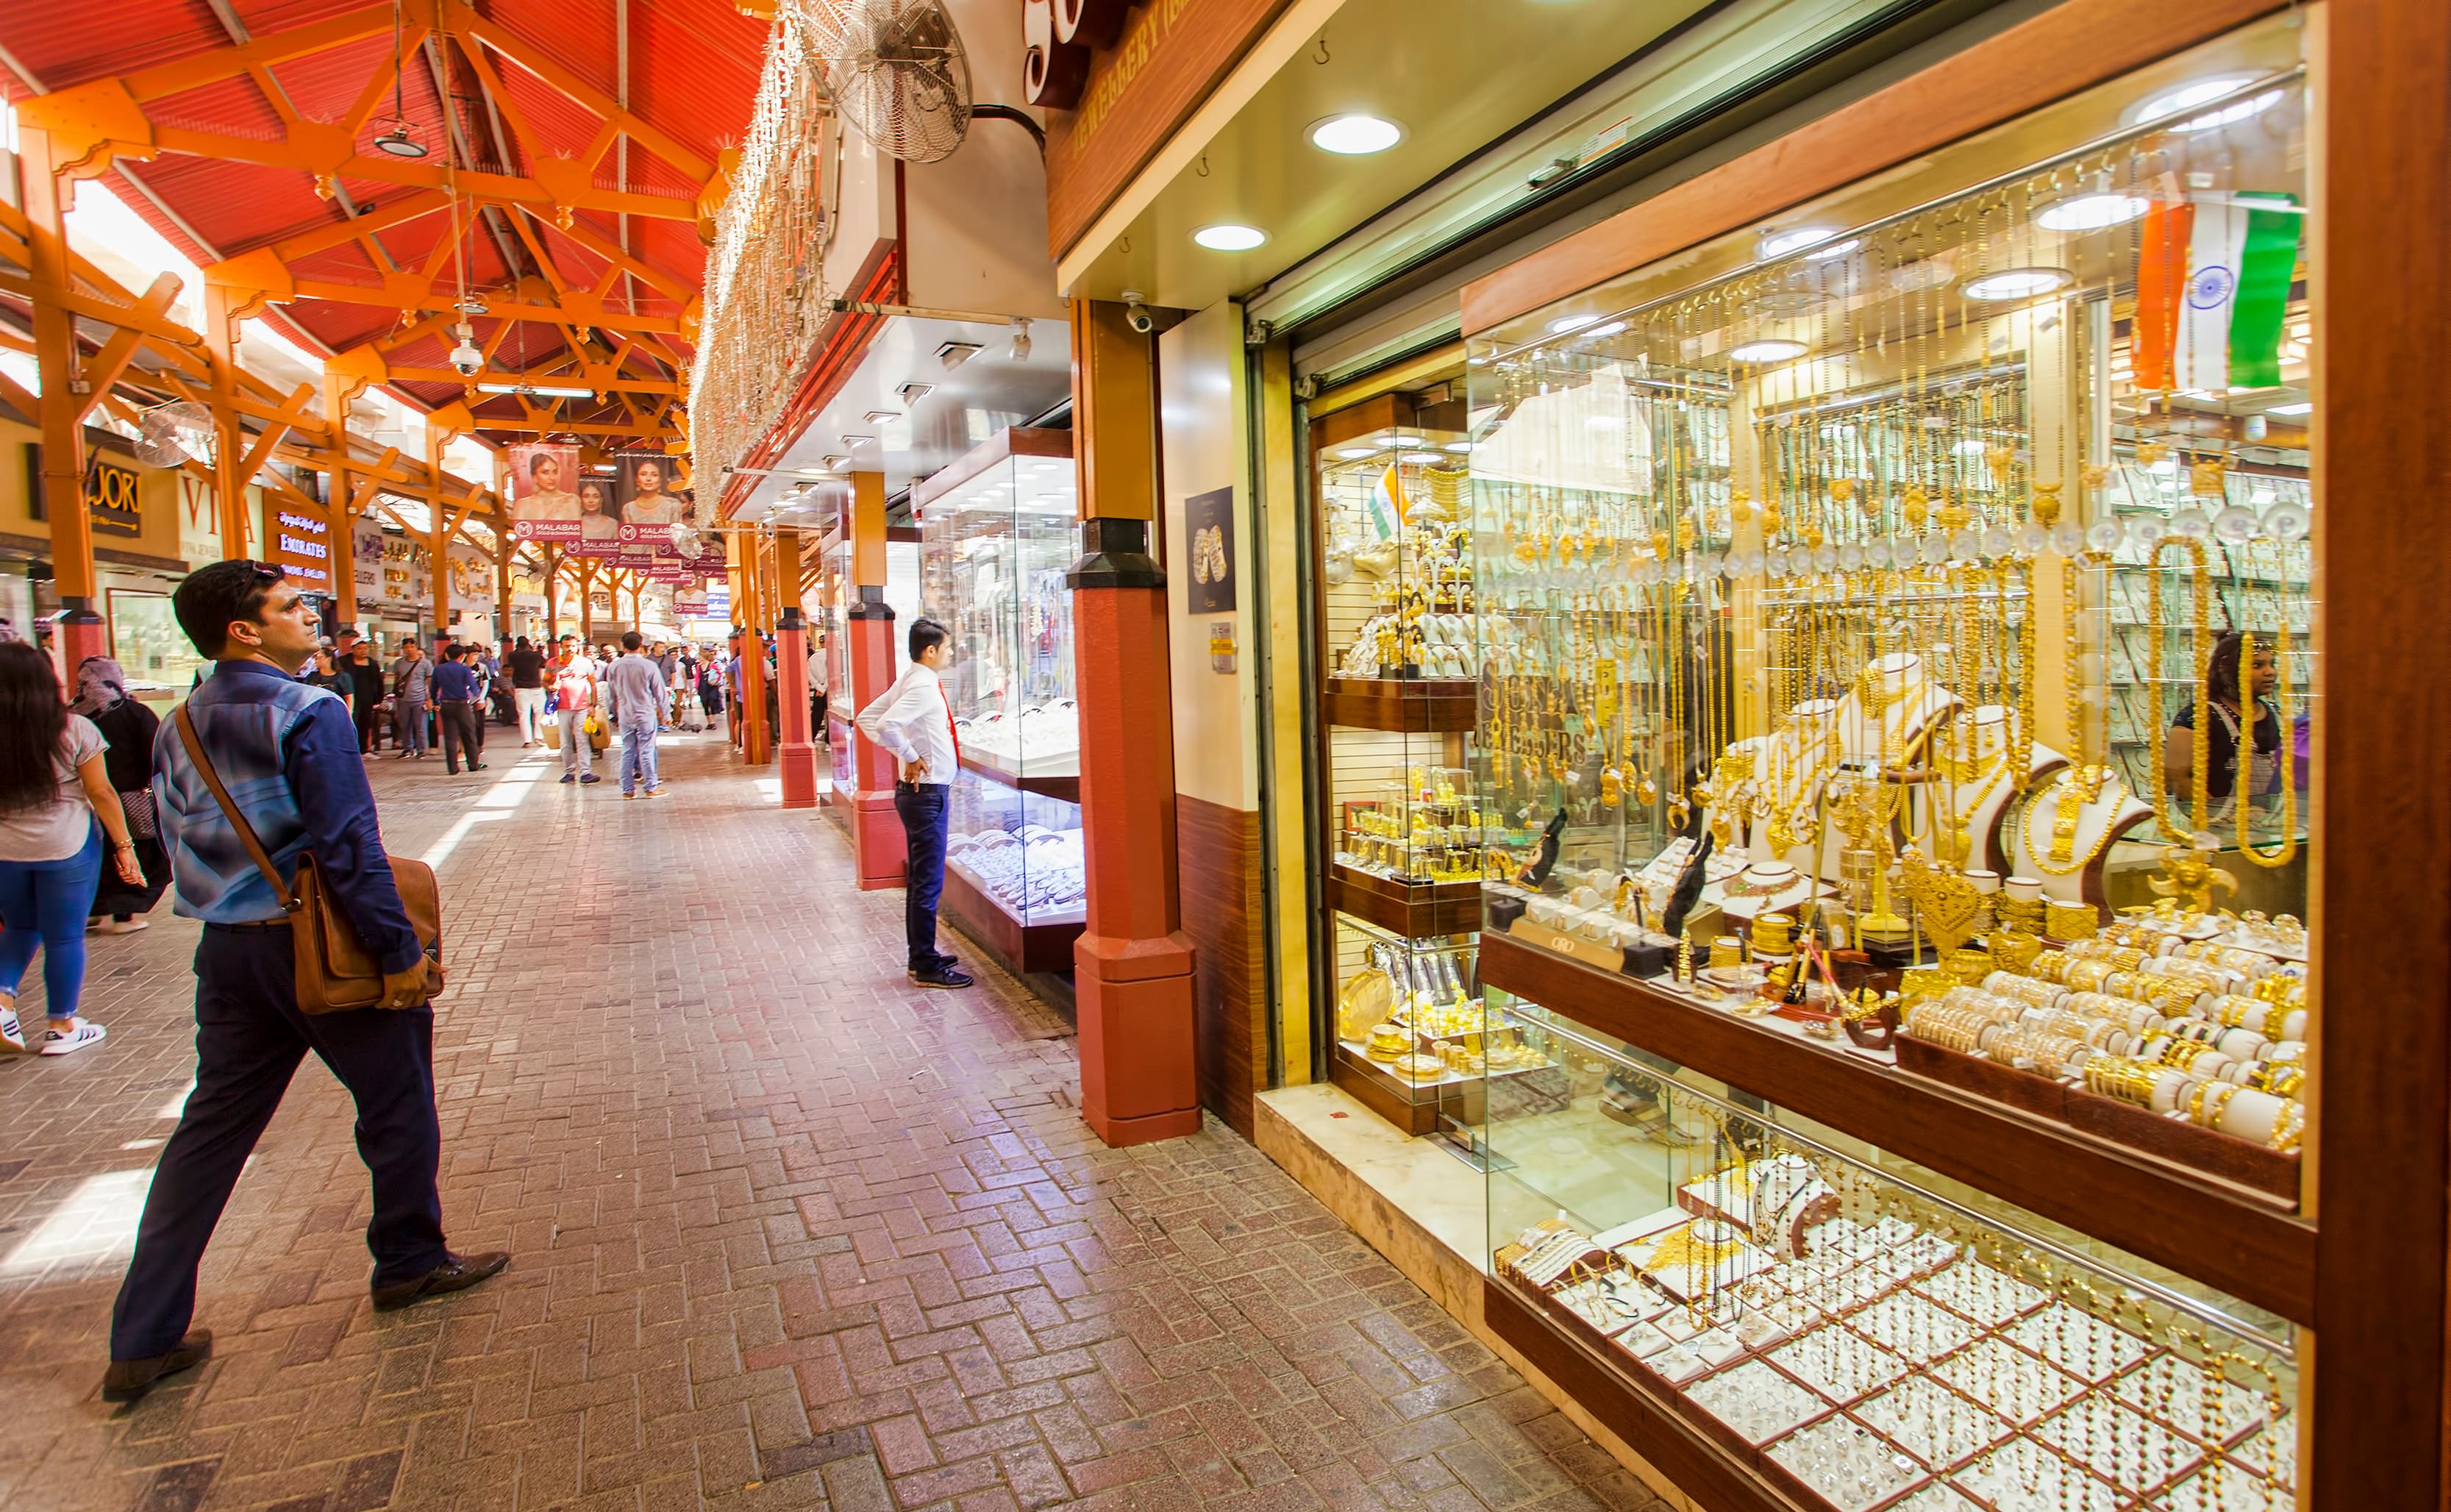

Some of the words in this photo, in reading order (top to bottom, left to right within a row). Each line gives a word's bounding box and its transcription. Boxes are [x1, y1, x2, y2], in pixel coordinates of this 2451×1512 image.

[1071, 4, 1160, 160] JEWELLERY
[88, 466, 141, 513] JORI
[181, 476, 255, 543] VIA
[536, 523, 581, 531] MALABAR
[280, 533, 327, 559] EMIRATES
[1552, 936, 1574, 952] ORO
